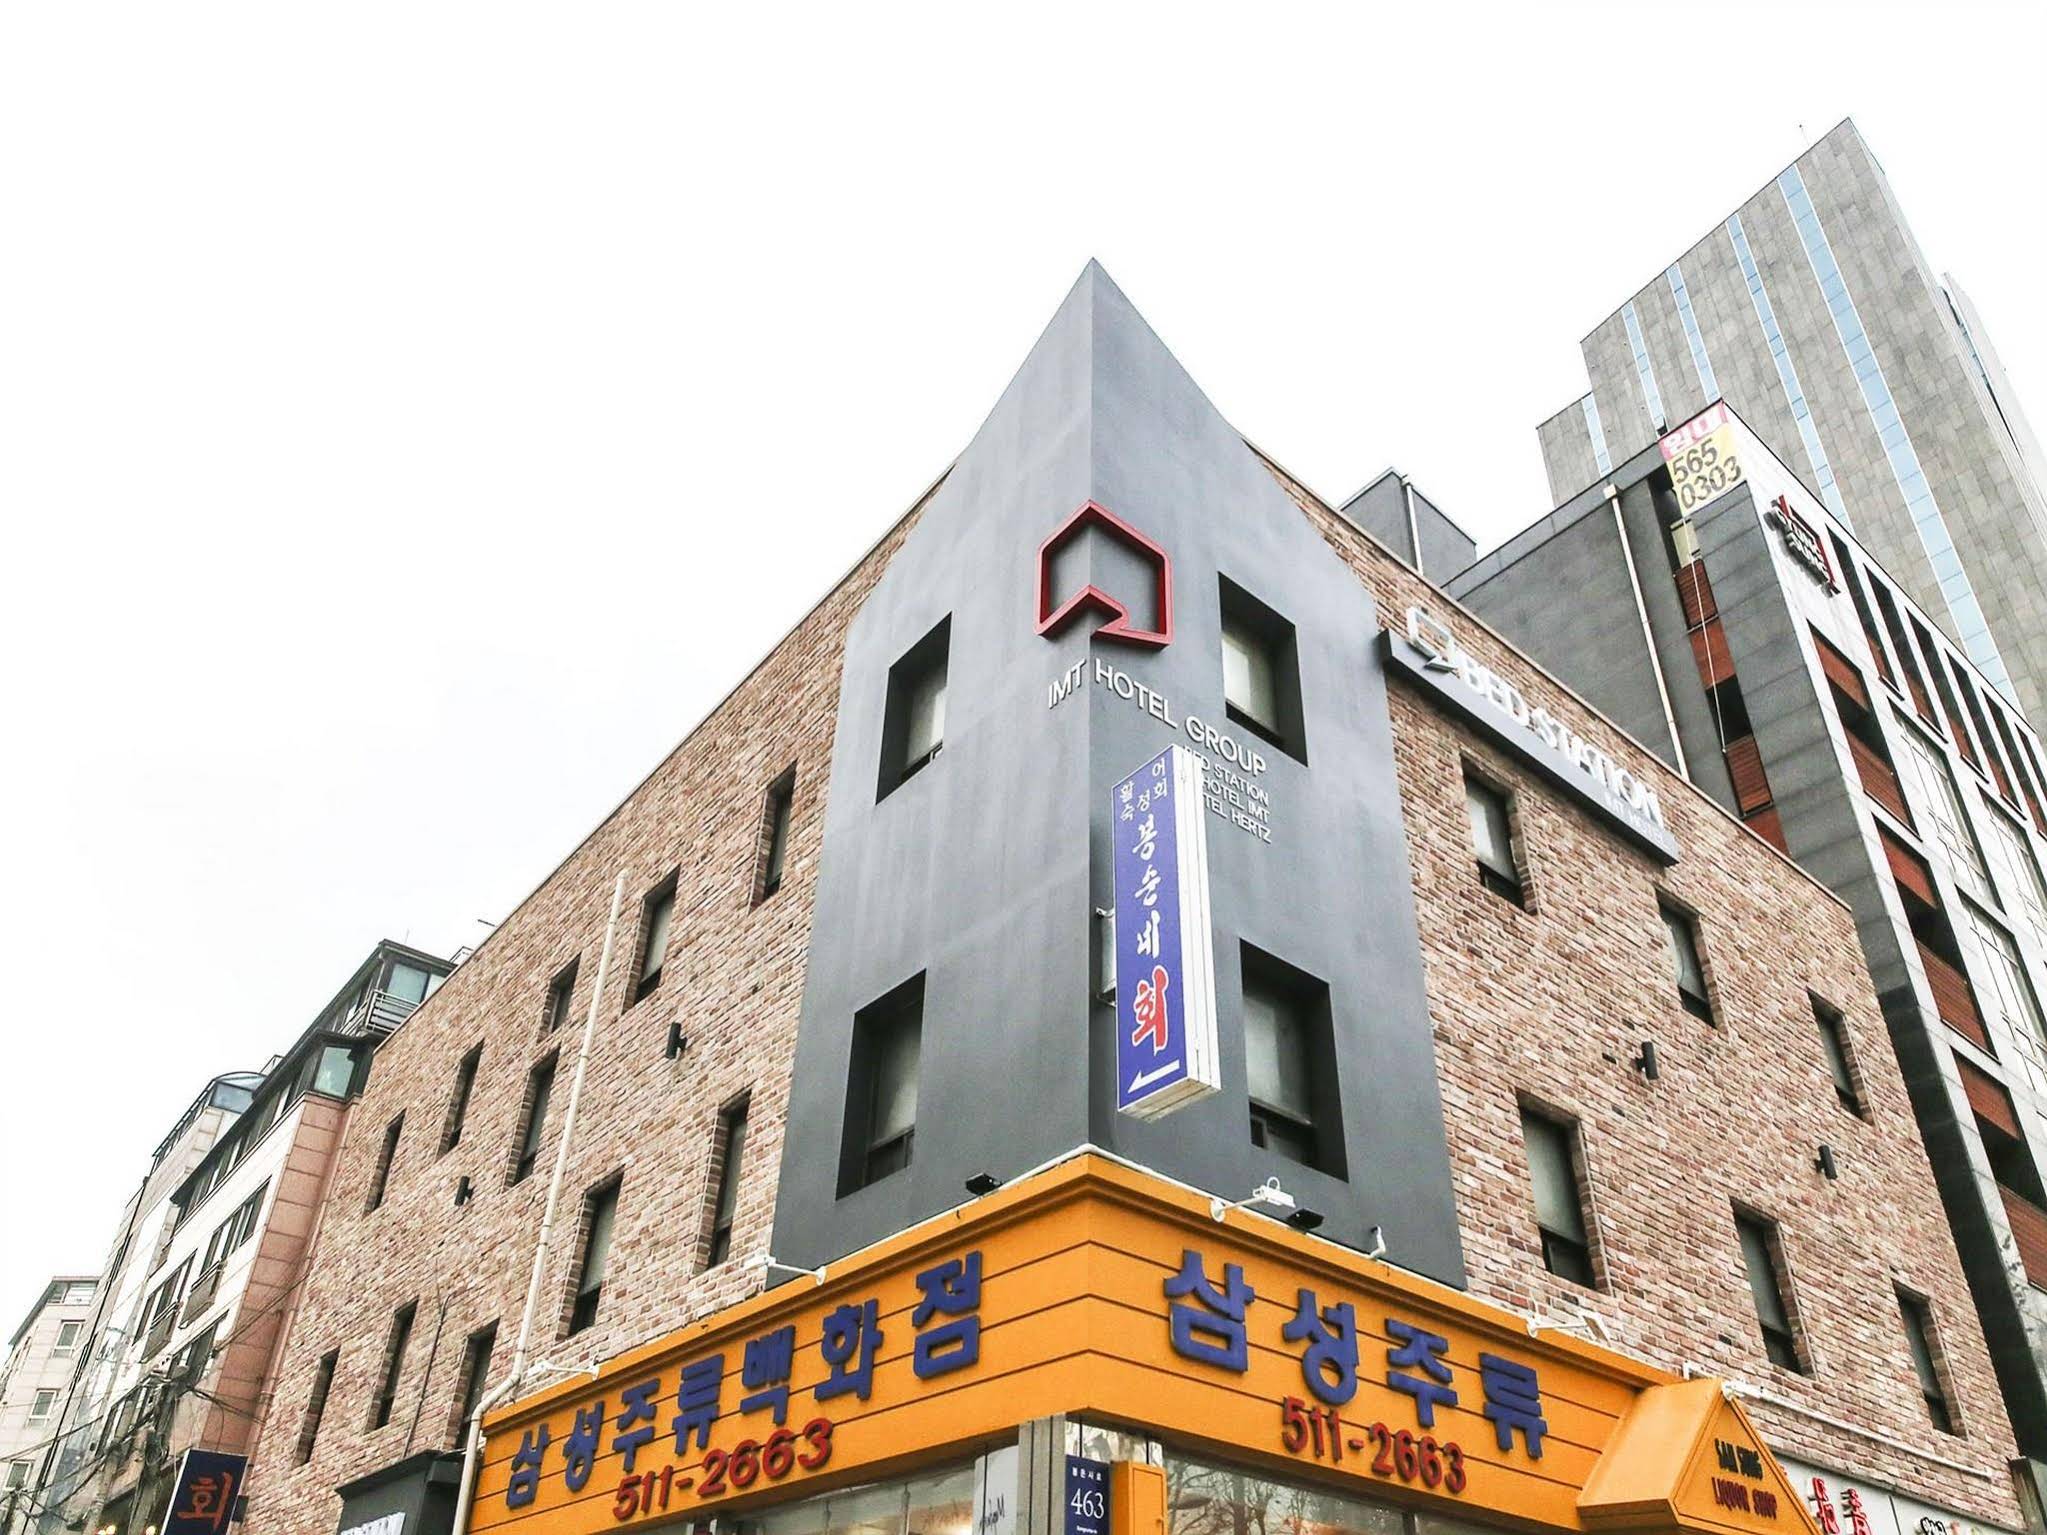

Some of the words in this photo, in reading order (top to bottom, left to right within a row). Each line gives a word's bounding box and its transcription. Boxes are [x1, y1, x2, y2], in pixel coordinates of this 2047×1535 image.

[1673, 438, 1717, 484] 565
[1680, 455, 1742, 509] 0303
[1049, 659, 1086, 709] IMT
[1095, 658, 1178, 729] HOTEL
[1185, 715, 1267, 777] GROUP
[1457, 651, 1530, 726] BED
[1532, 706, 1664, 828] STATION
[1203, 777, 1245, 811] HOTEL
[1248, 800, 1270, 824] IMT
[1214, 764, 1269, 807] STATION
[1230, 808, 1271, 844] HERTZ
[1132, 965, 1168, 1053] 회
[506, 1251, 983, 1509] 삼성주류백화점
[1164, 1249, 1548, 1460] 삼성주류
[612, 1417, 834, 1521] 511-2663
[1282, 1396, 1466, 1494] 511-2663
[178, 1472, 231, 1531] 회
[1071, 1488, 1104, 1519] 463
